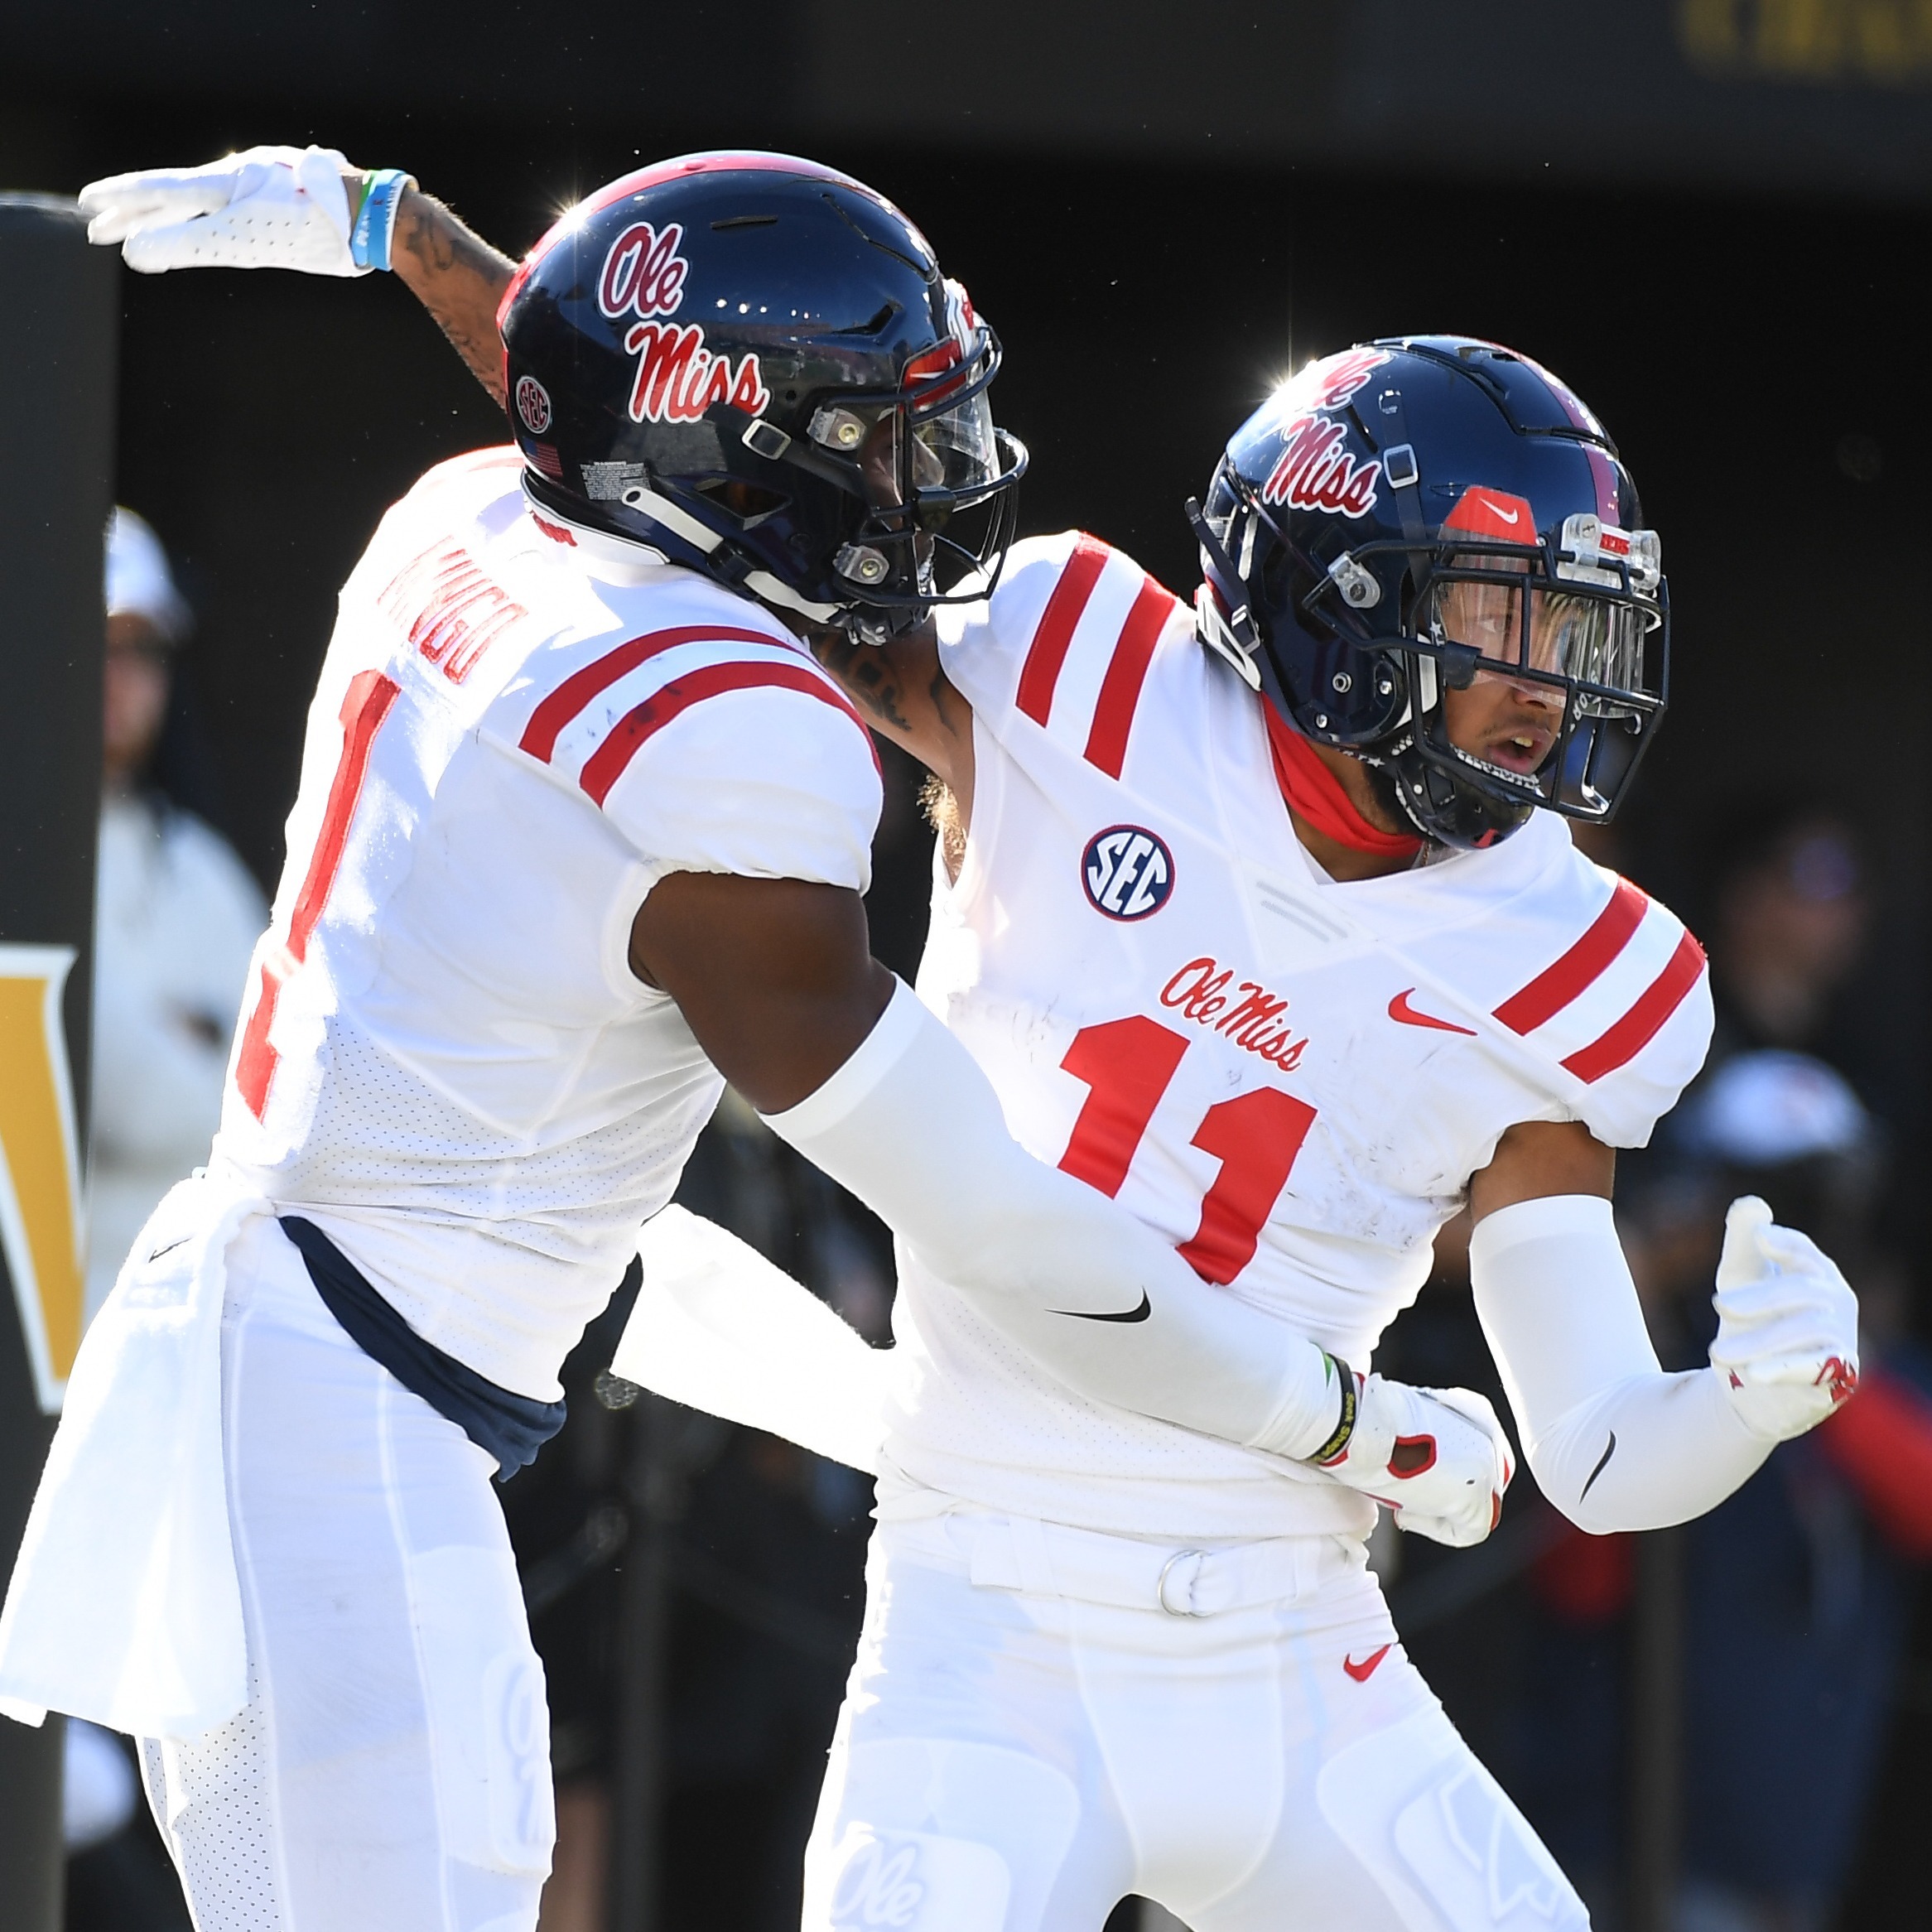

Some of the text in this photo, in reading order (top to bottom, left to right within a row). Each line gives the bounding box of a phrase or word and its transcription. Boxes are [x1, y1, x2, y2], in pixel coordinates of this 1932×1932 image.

[598, 222, 690, 318] Ole
[519, 379, 548, 431] SEC
[624, 321, 769, 423] Miss
[1263, 413, 1382, 518] Miss
[1085, 828, 1169, 918] SEC
[1159, 956, 1311, 1072] Ole Miss
[1056, 1014, 1318, 1287] 11
